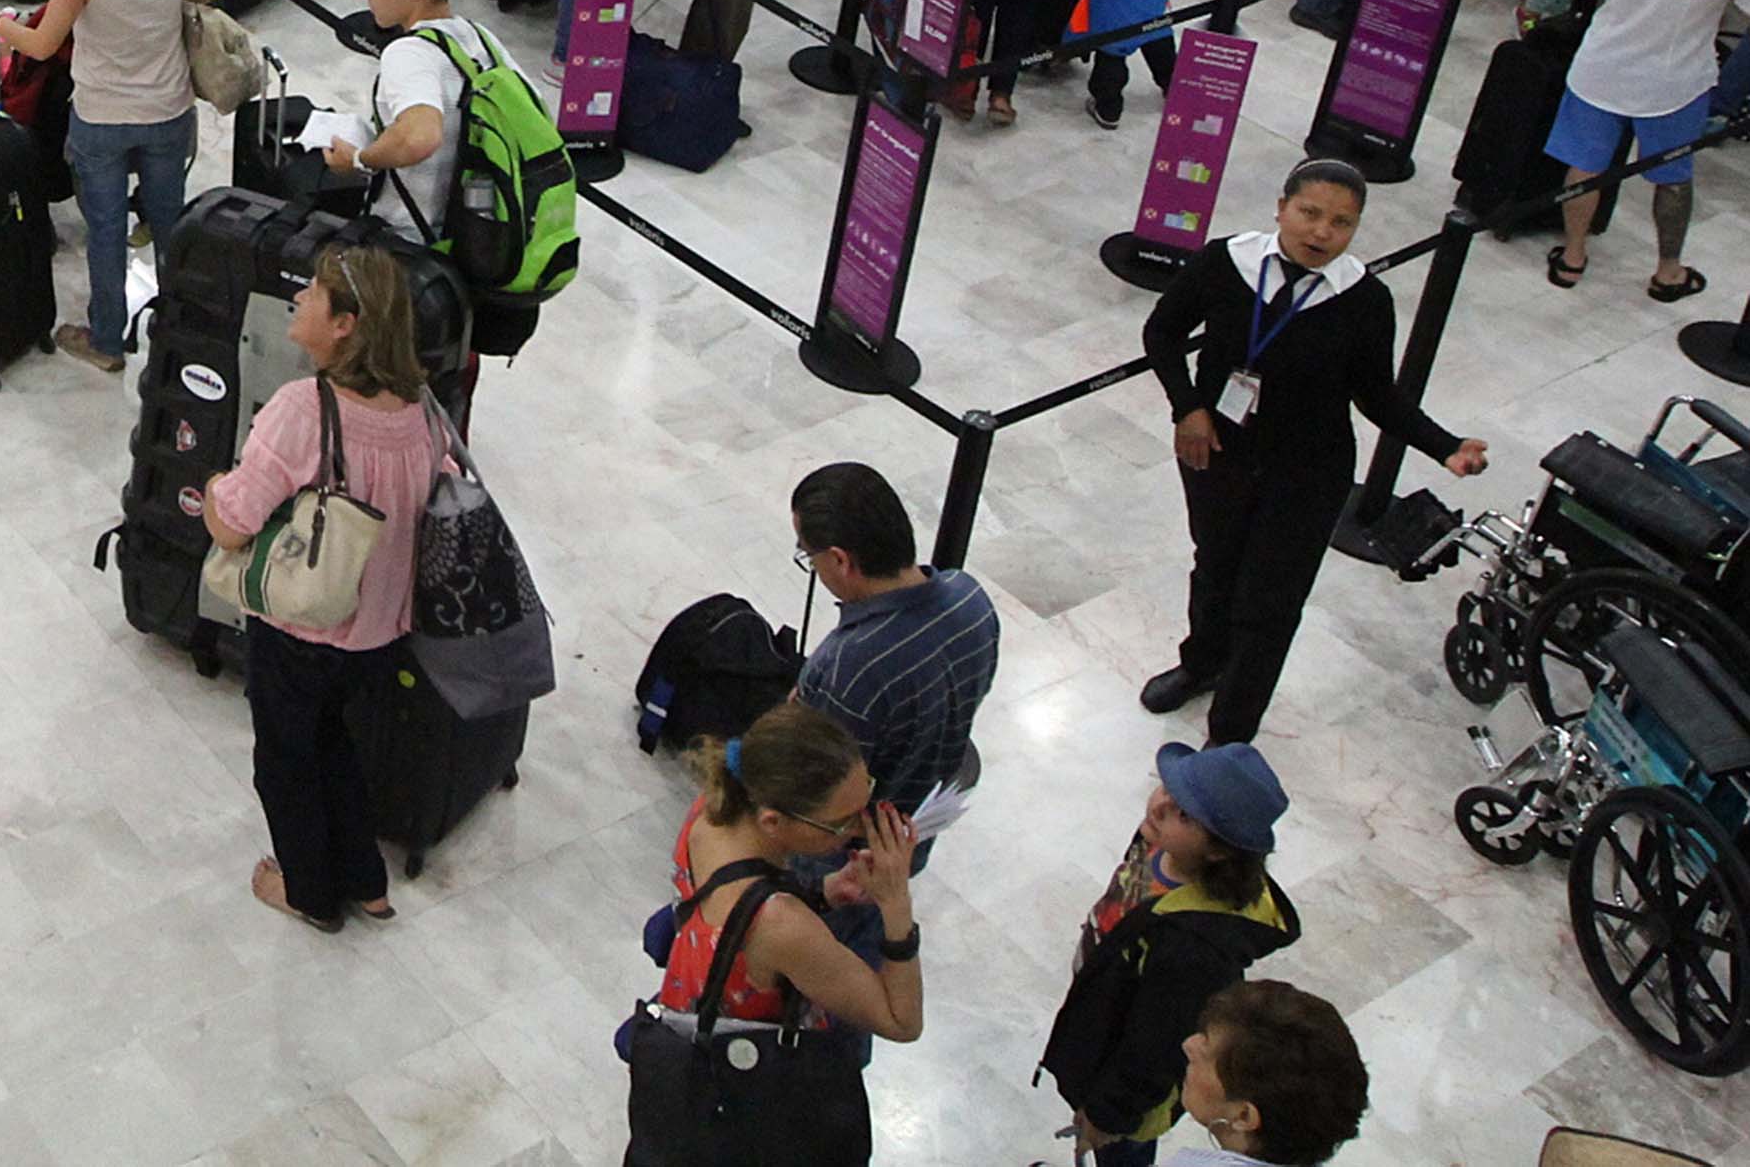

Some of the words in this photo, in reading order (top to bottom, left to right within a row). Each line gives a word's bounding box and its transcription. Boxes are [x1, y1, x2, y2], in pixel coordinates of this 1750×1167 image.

[1020, 50, 1055, 66] volaris
[628, 217, 666, 247] volaris
[770, 308, 812, 341] volaris
